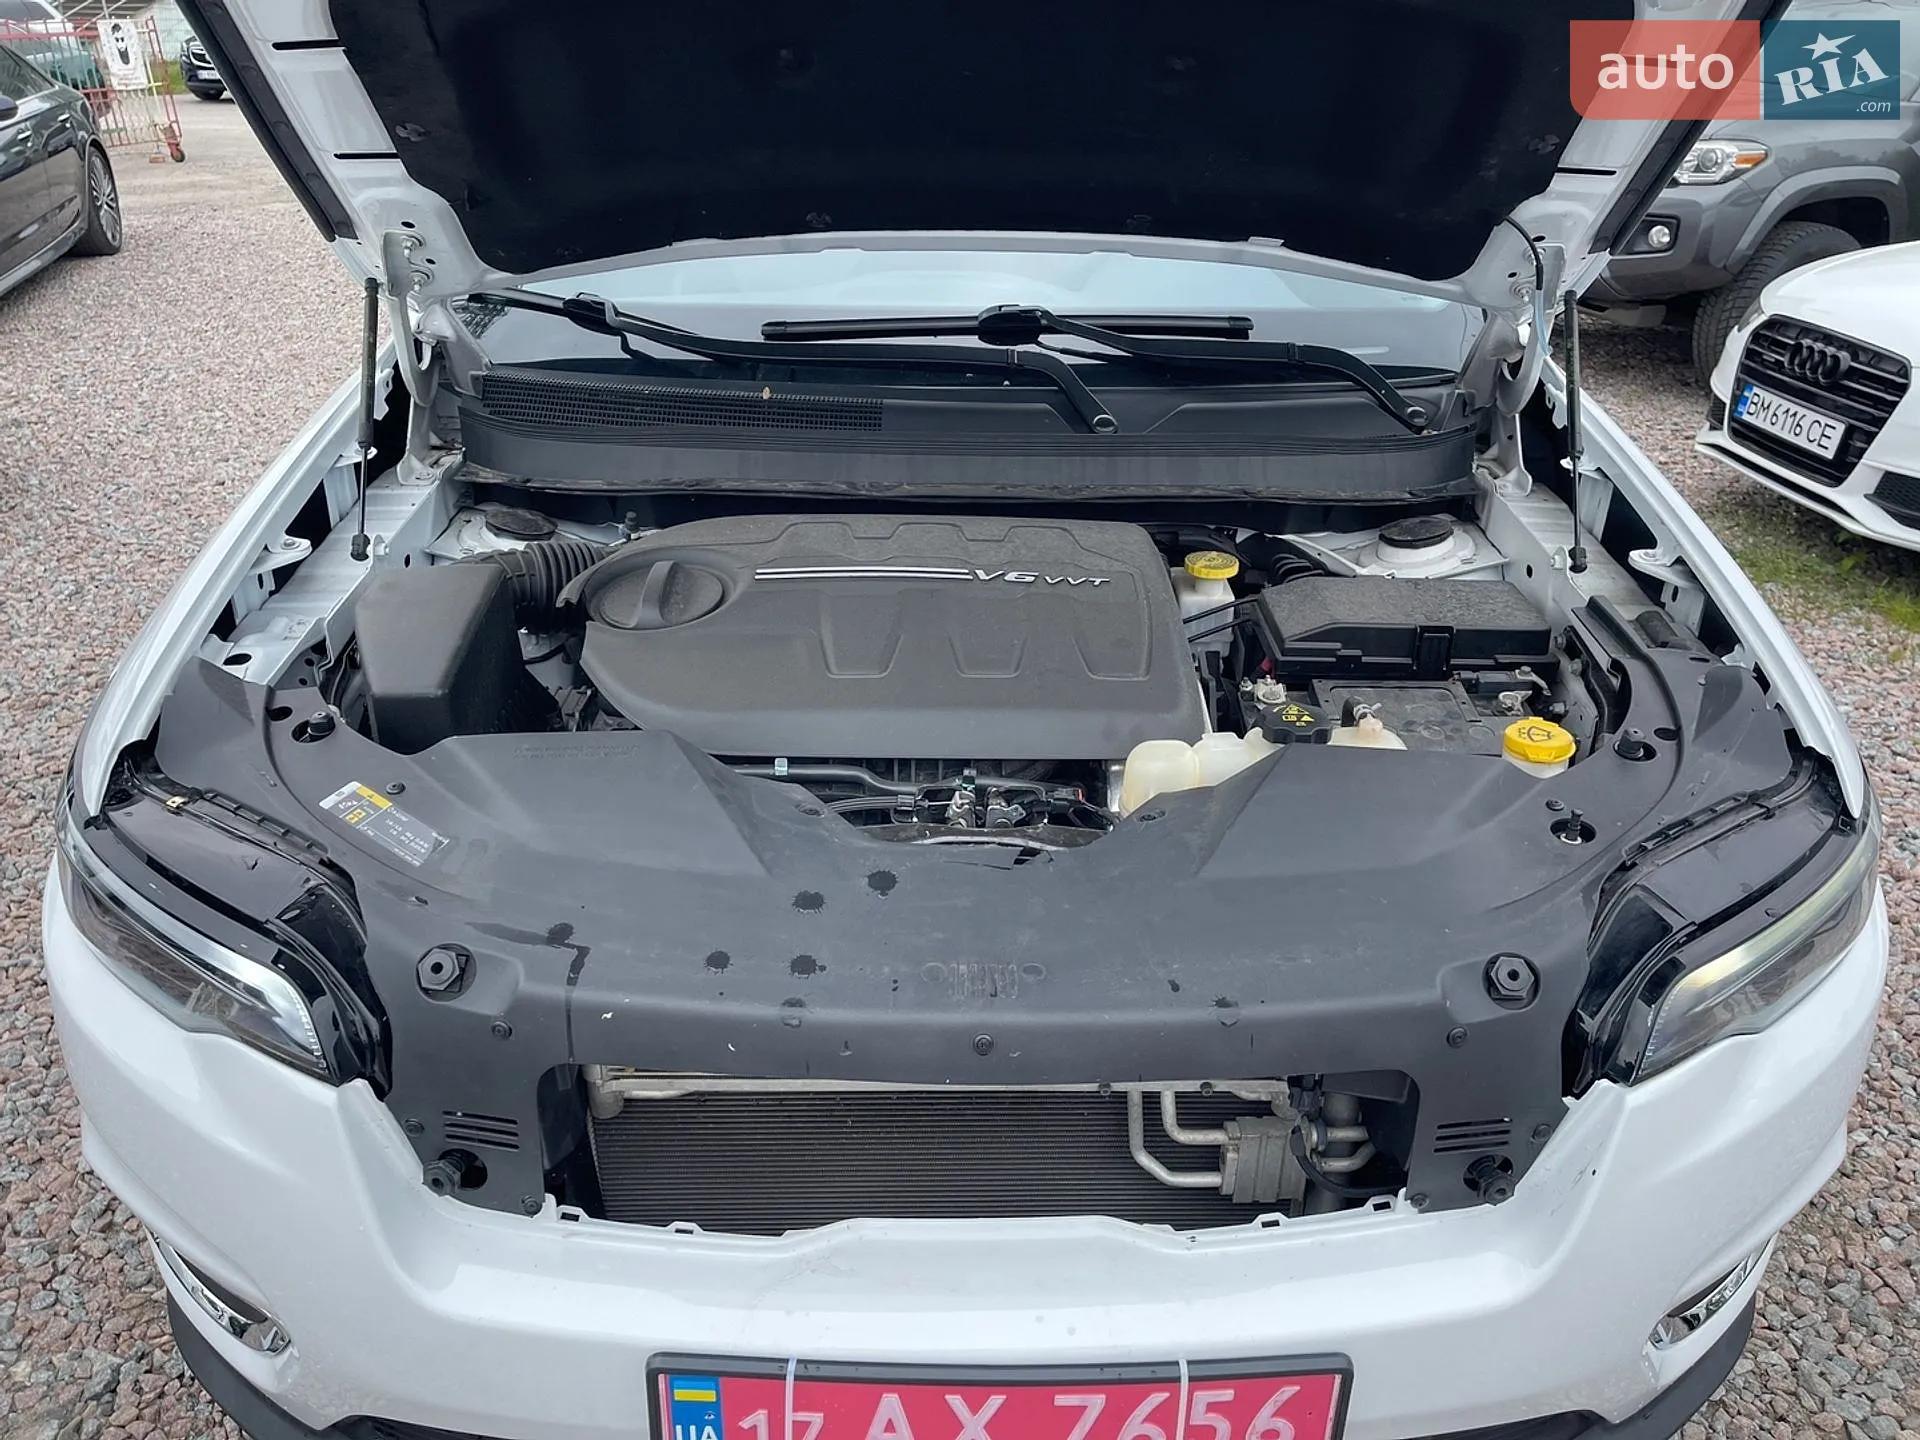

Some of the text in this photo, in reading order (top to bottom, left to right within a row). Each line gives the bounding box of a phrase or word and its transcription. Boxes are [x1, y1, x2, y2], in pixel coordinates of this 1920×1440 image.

[1746, 391, 1837, 451] BM 6116 CE
[973, 568, 1111, 586] V6 VVT
[1053, 1386, 1301, 1440] 7656
